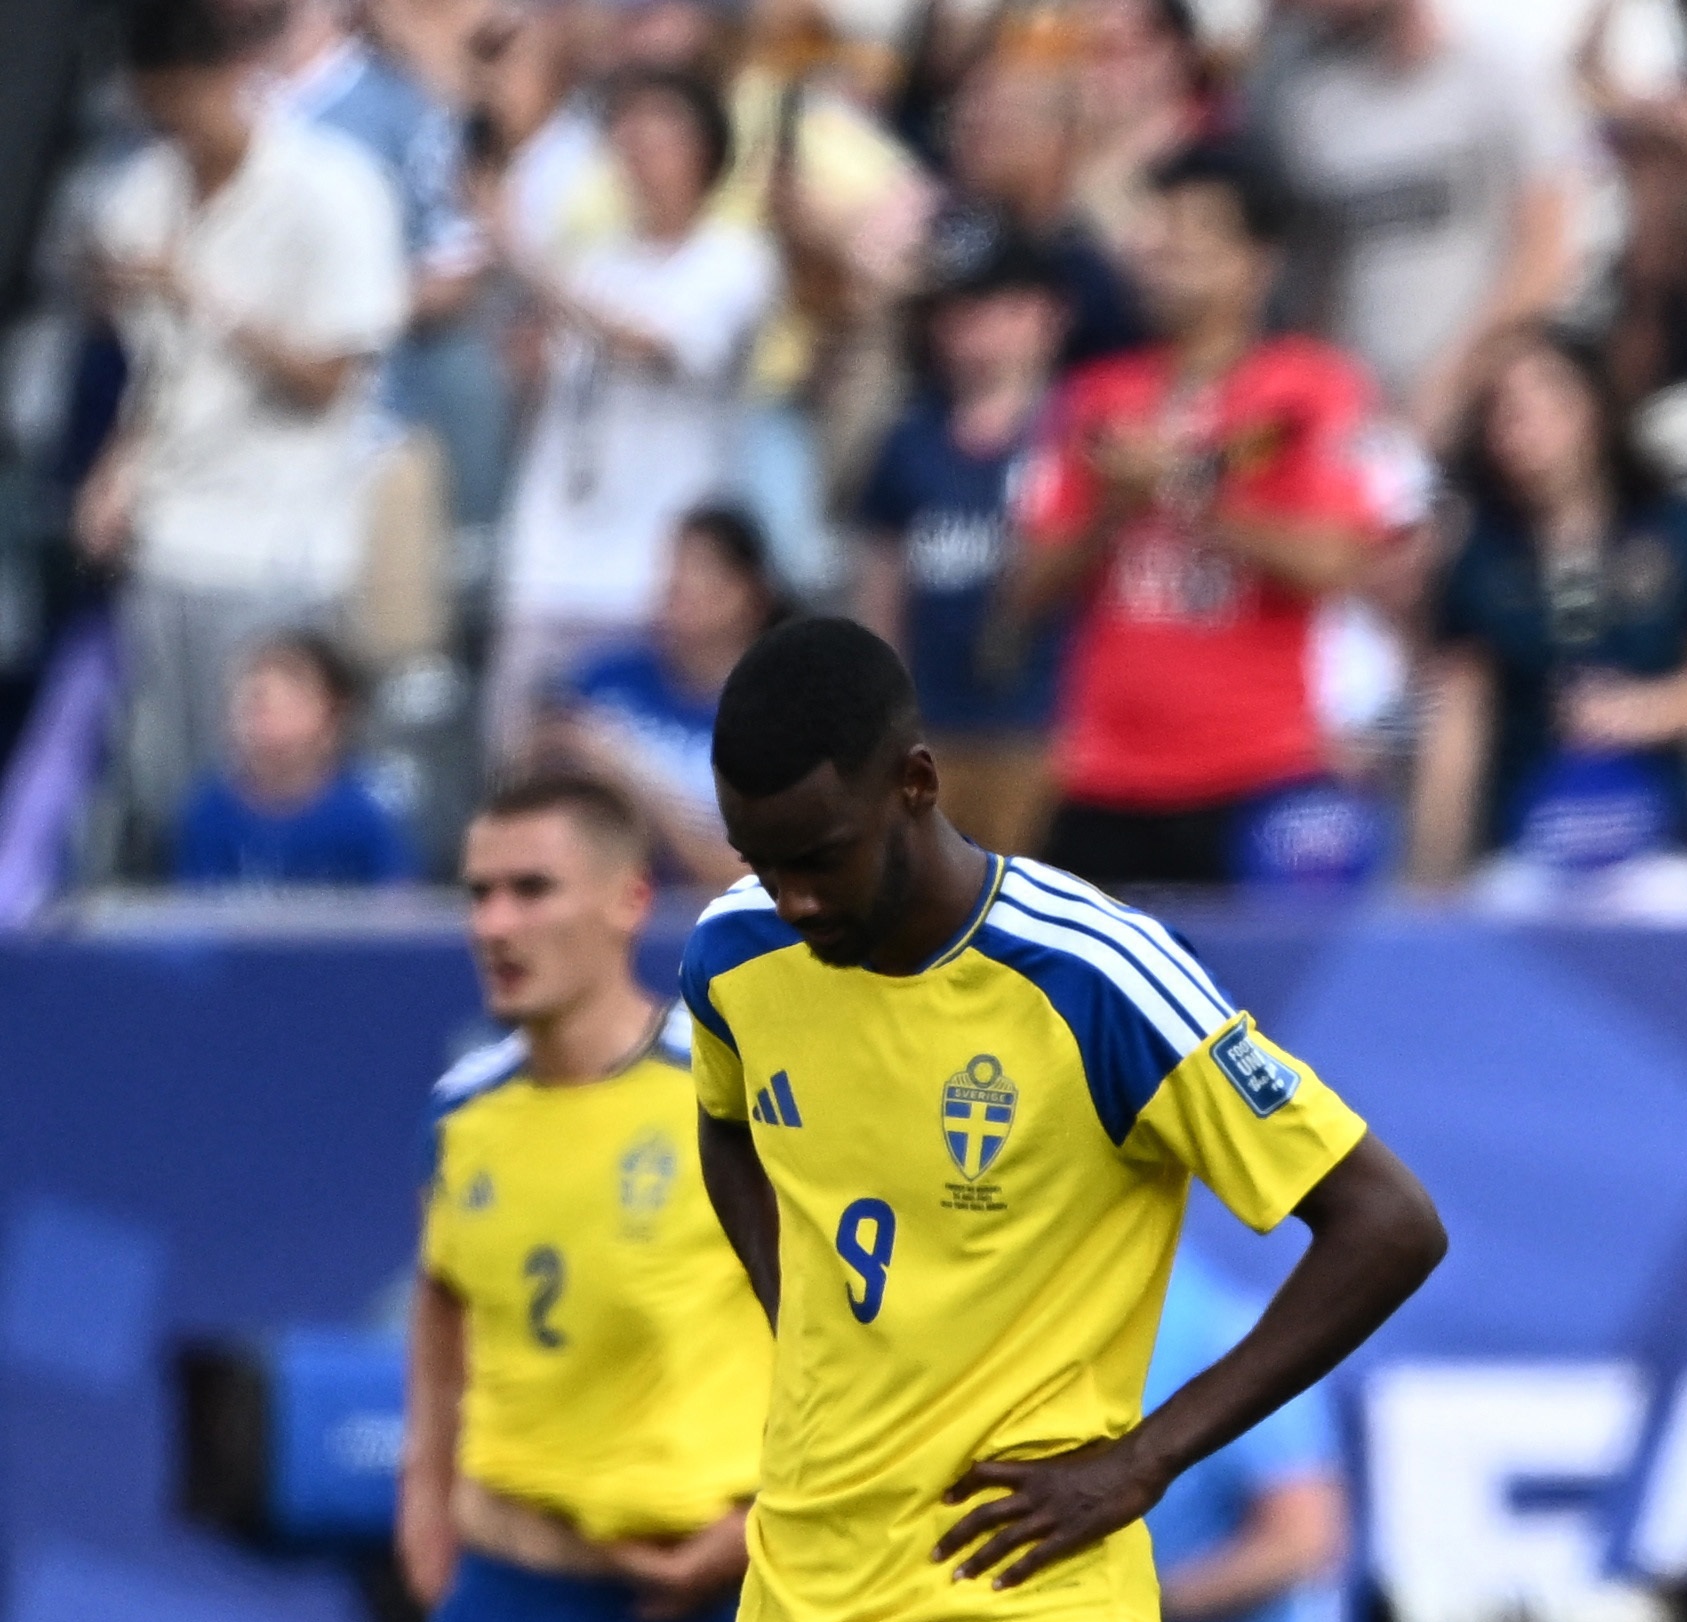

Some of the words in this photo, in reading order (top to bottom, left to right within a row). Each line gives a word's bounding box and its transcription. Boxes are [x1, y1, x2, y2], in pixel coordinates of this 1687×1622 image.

[954, 1088, 1007, 1103] SVERIGE
[522, 1242, 567, 1351] 2
[835, 1196, 896, 1325] 9
